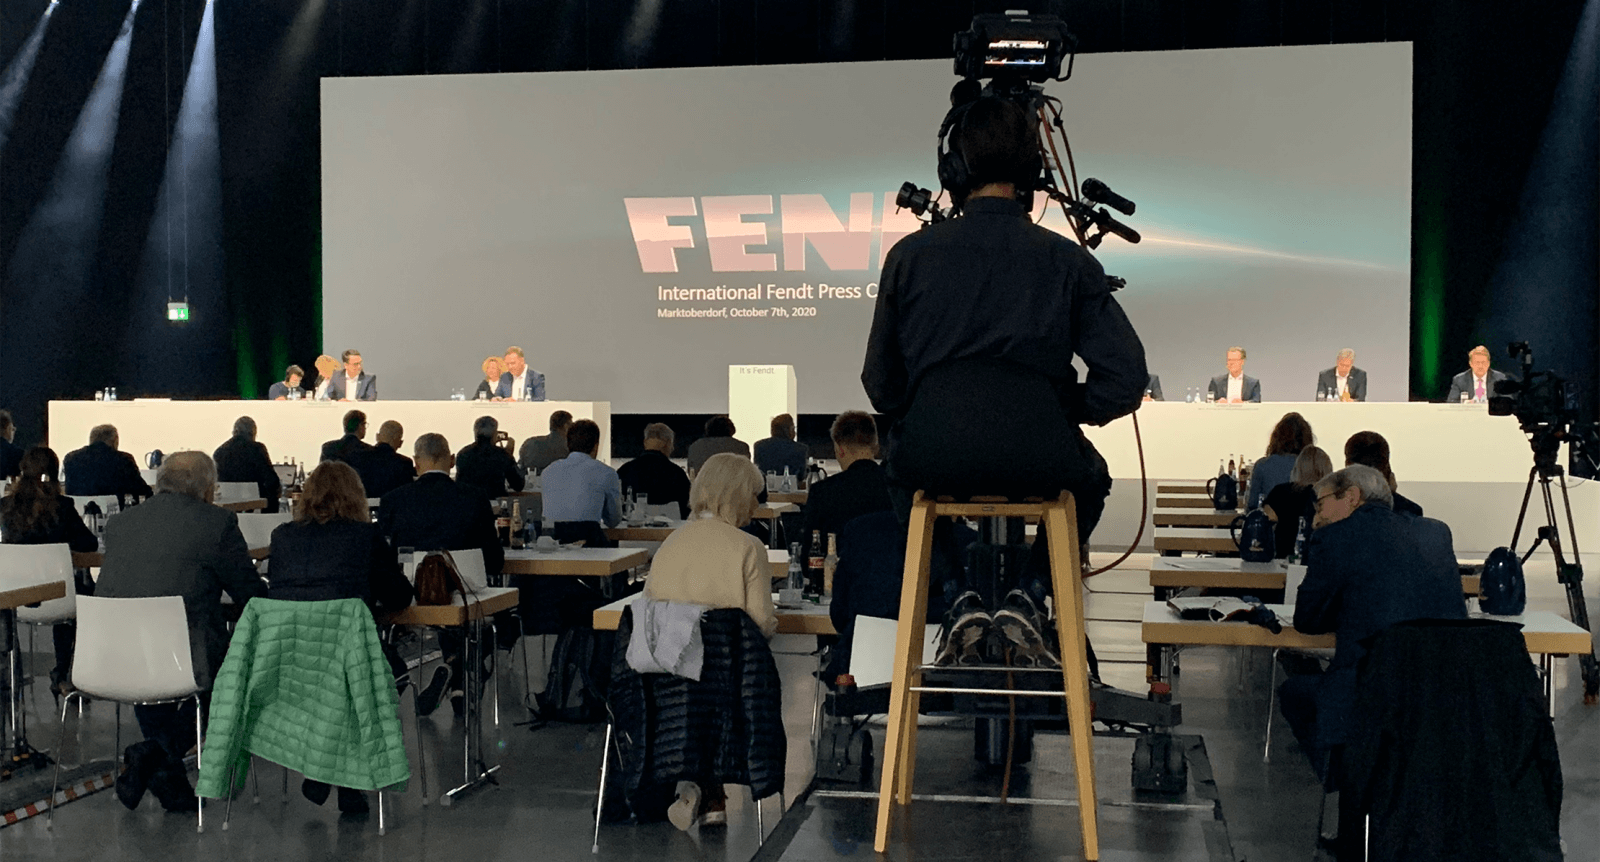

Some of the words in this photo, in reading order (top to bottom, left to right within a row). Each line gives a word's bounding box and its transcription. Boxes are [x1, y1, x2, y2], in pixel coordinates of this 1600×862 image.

[623, 191, 1066, 273] FEN
[658, 283, 762, 301] International
[766, 282, 814, 300] Fendt
[818, 282, 862, 299] Press
[657, 307, 729, 319] Marktoberdorf,
[729, 306, 769, 318] October
[770, 306, 790, 318] 7th,
[791, 306, 817, 317] 2020
[752, 366, 775, 375] Fendt
